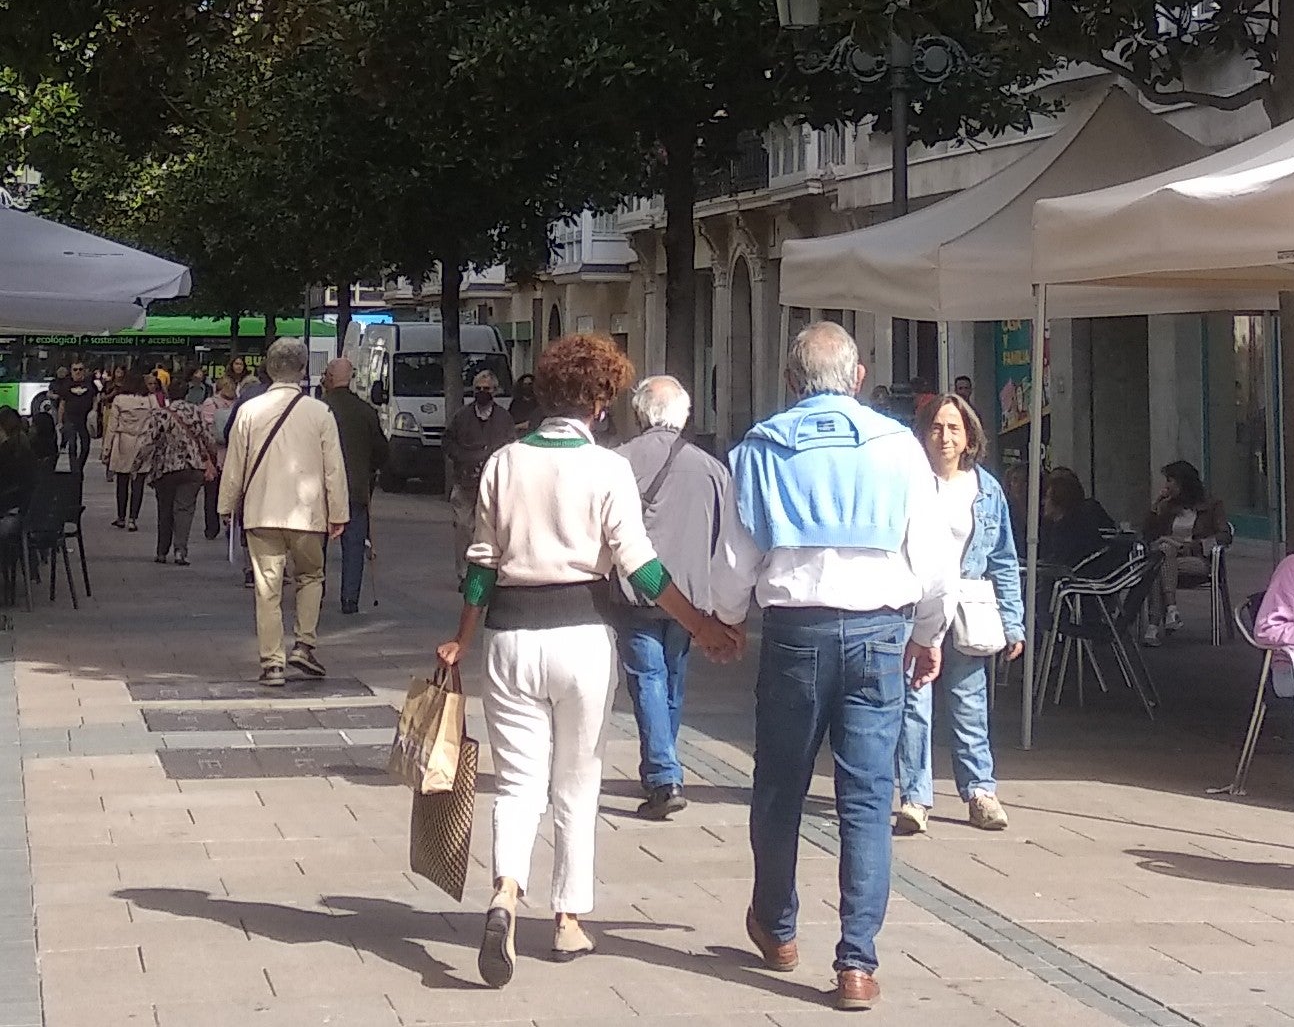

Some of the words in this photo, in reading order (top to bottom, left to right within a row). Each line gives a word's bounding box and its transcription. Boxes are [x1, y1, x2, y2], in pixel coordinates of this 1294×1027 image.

[36, 335, 77, 346] ecológico
[91, 336, 134, 344] sostenible
[148, 336, 186, 344] accesible
